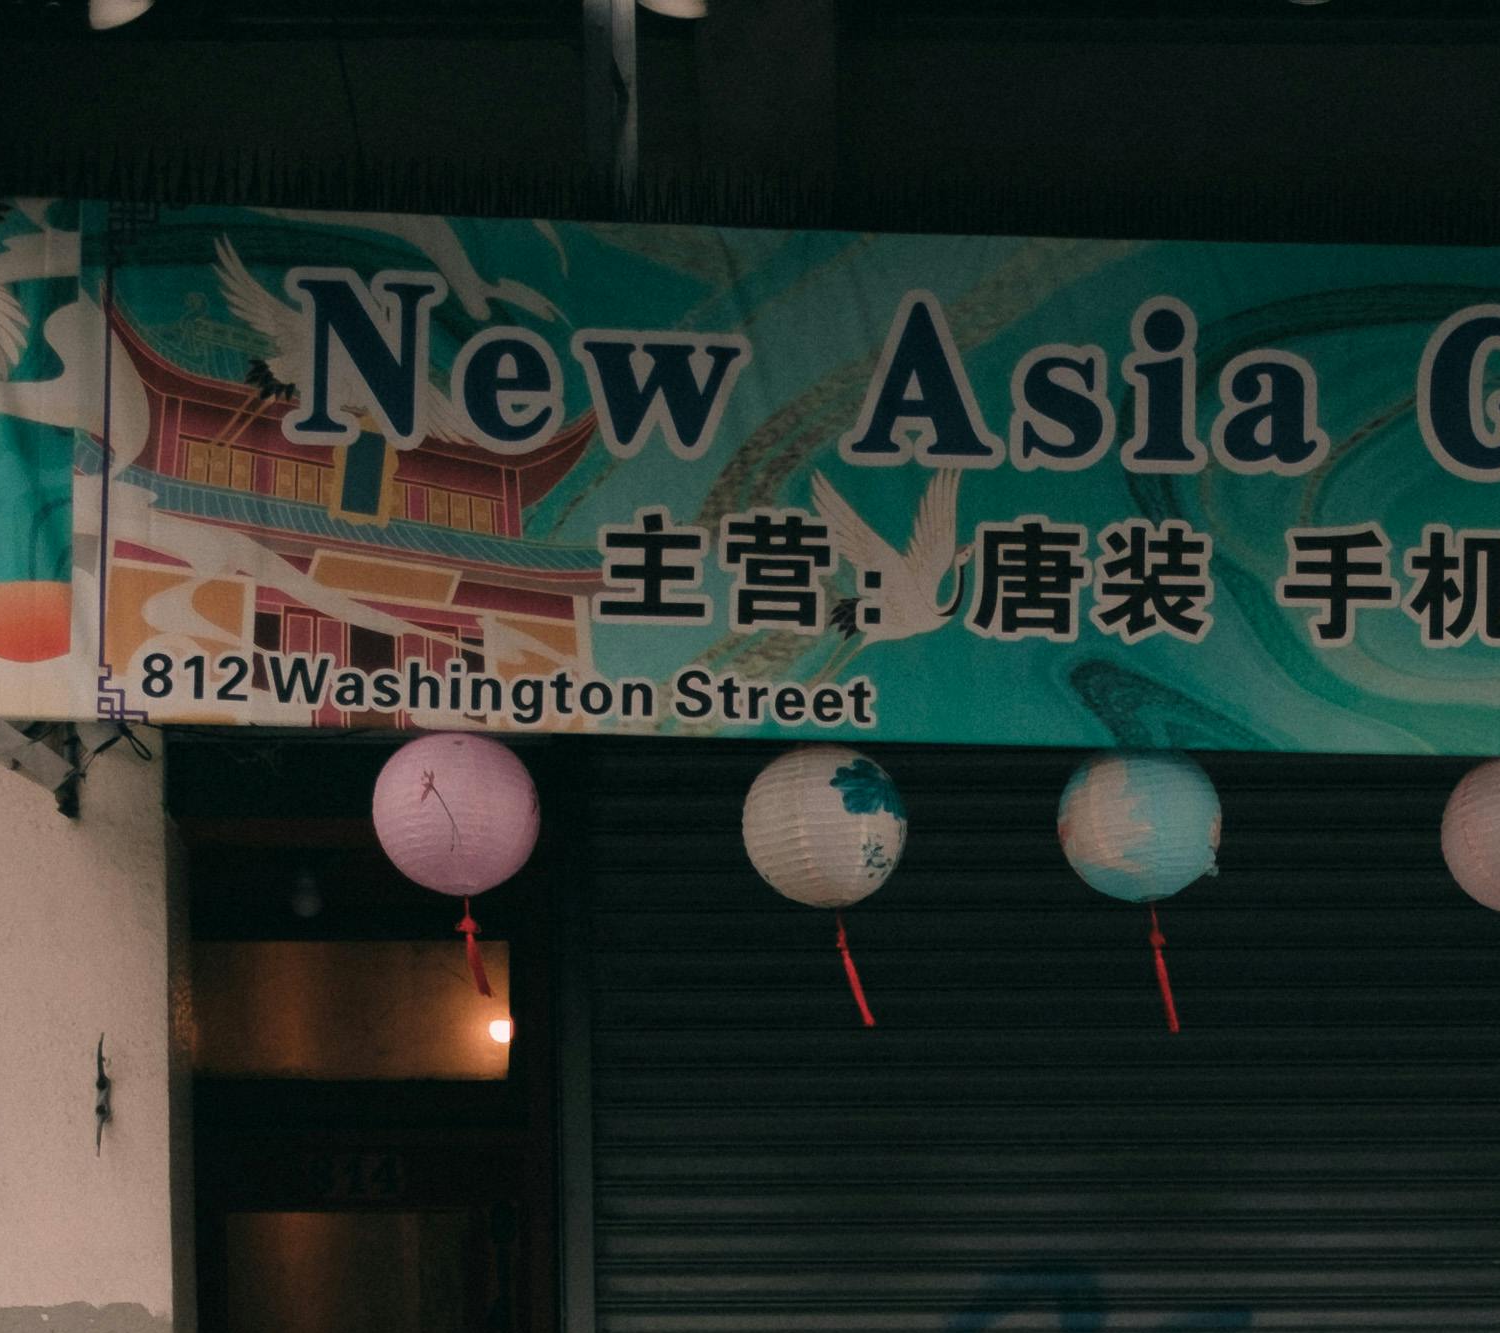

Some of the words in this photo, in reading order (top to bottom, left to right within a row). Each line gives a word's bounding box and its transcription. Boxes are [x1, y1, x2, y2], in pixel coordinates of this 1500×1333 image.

[290, 274, 744, 450] New
[851, 300, 1320, 465] Asia
[971, 520, 1210, 638] 唐装
[139, 651, 252, 704] 812
[268, 656, 657, 728] Washington
[673, 670, 873, 727] Street
